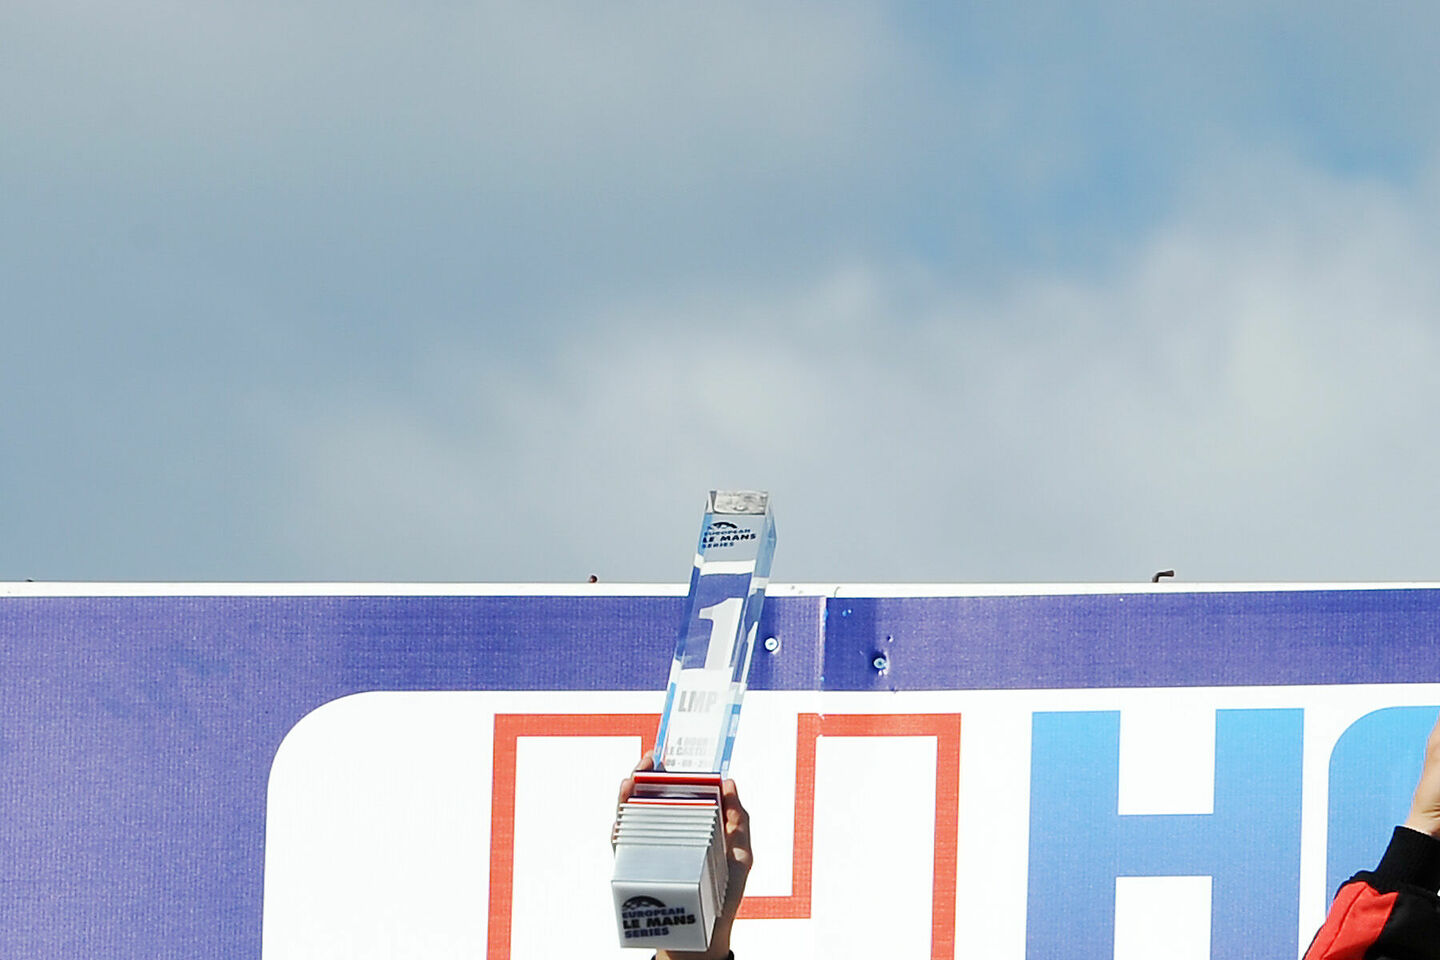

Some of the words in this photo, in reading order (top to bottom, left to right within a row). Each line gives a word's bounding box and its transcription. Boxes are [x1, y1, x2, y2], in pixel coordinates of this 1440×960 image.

[719, 533, 756, 542] MANS
[698, 597, 744, 671] 1
[622, 907, 685, 919] EUROPEAN
[623, 919, 640, 930] LE
[646, 914, 696, 928] MANS
[624, 927, 670, 939] SERIES
